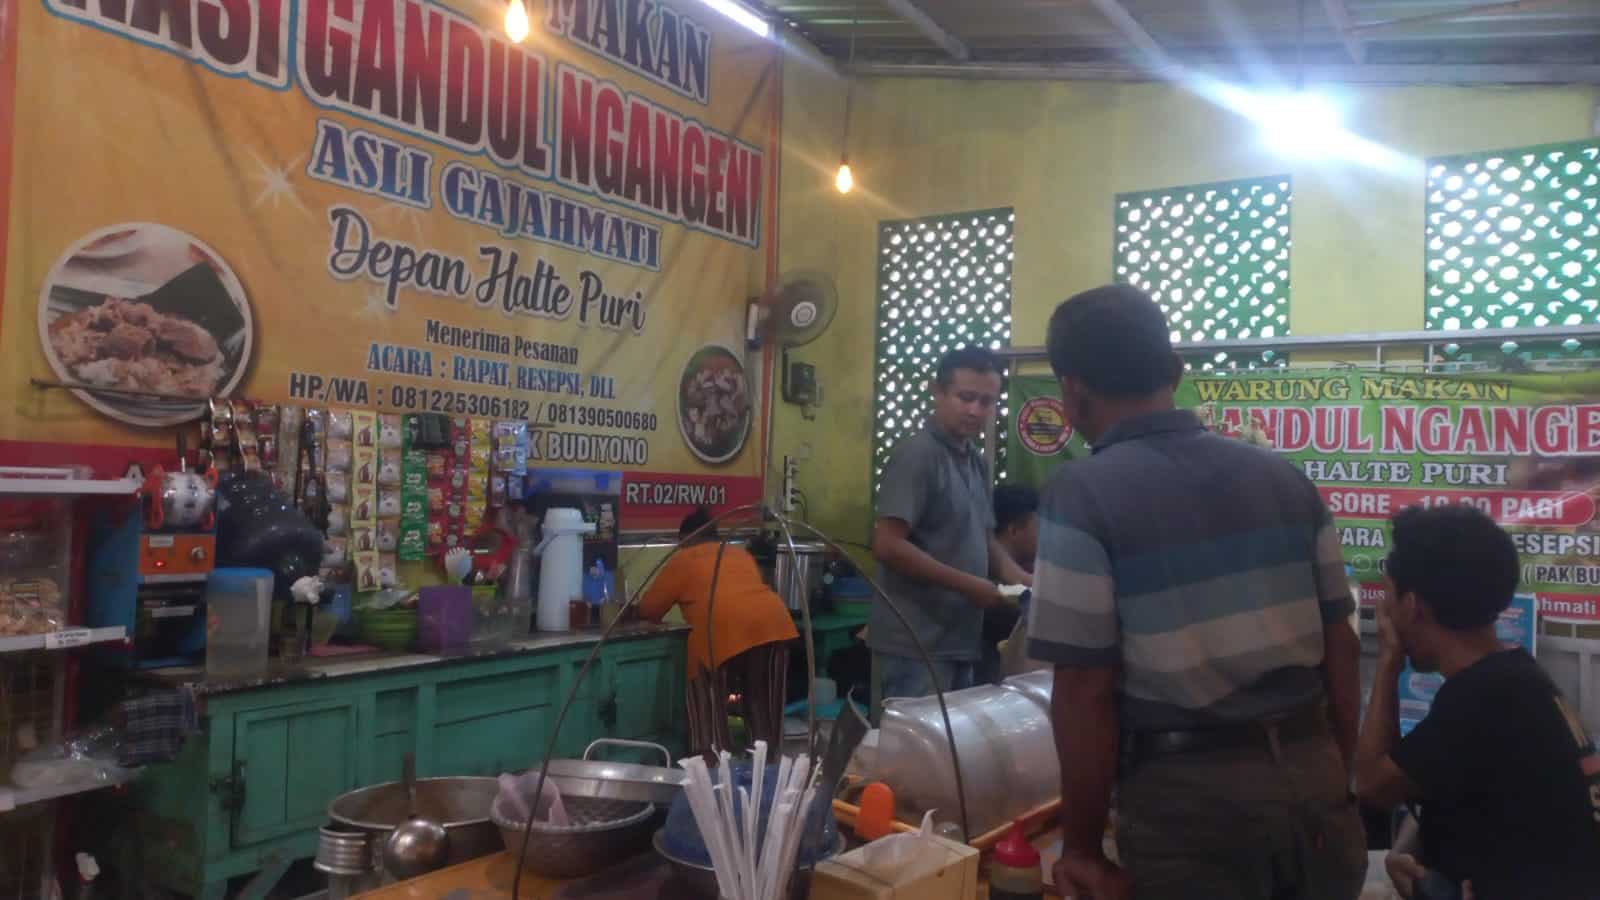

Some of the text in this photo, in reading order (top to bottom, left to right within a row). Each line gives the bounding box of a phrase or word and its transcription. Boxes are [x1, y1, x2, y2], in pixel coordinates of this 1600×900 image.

[559, 66, 762, 246] NGANGENI
[311, 119, 660, 269] ASLI GAJAHMATI
[329, 207, 646, 330] Depan Halte Puri
[425, 319, 579, 366] Menerima Pesanan
[367, 343, 433, 377] ACARA
[453, 354, 513, 389] RAPAT,
[516, 365, 585, 398] RESEPSI,
[1196, 378, 1510, 401] WARUNG MAKAN
[289, 372, 369, 405] HP./WA
[391, 385, 529, 420] 081225306182
[548, 403, 657, 431] 081390500680
[548, 431, 648, 465] BUDIYONO
[1210, 406, 1373, 453] ANDUL
[1303, 461, 1508, 485] HALTE PURI
[626, 482, 726, 505] RT.02/RW.01
[1329, 492, 1391, 514] SORE
[1535, 565, 1571, 584] PAK
[1537, 598, 1596, 615] hmati
